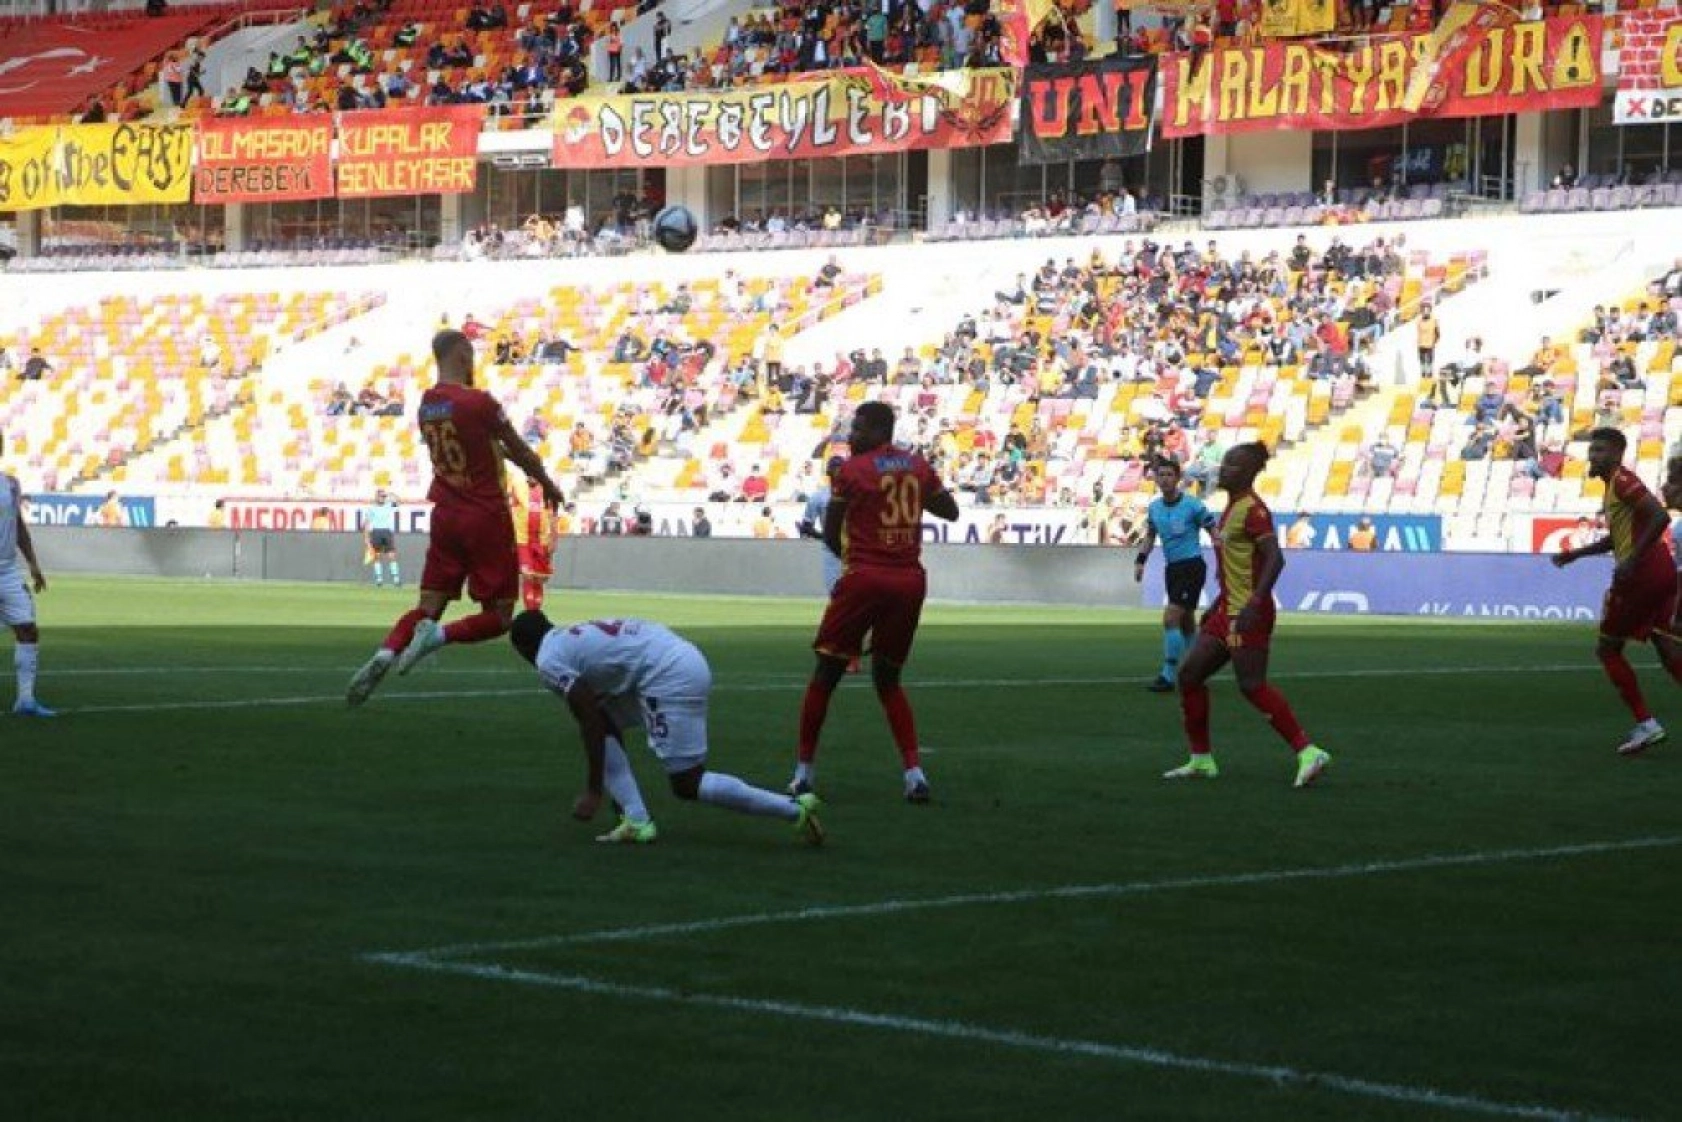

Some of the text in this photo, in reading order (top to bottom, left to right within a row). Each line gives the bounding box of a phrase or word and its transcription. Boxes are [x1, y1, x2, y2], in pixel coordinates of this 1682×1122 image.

[1174, 39, 1406, 126] MALATYA
[1029, 69, 1149, 138] UNI
[201, 127, 328, 160] OLMASADA
[338, 122, 453, 155] KUPALAR
[230, 506, 345, 533] MERCN
[881, 475, 919, 525] 30
